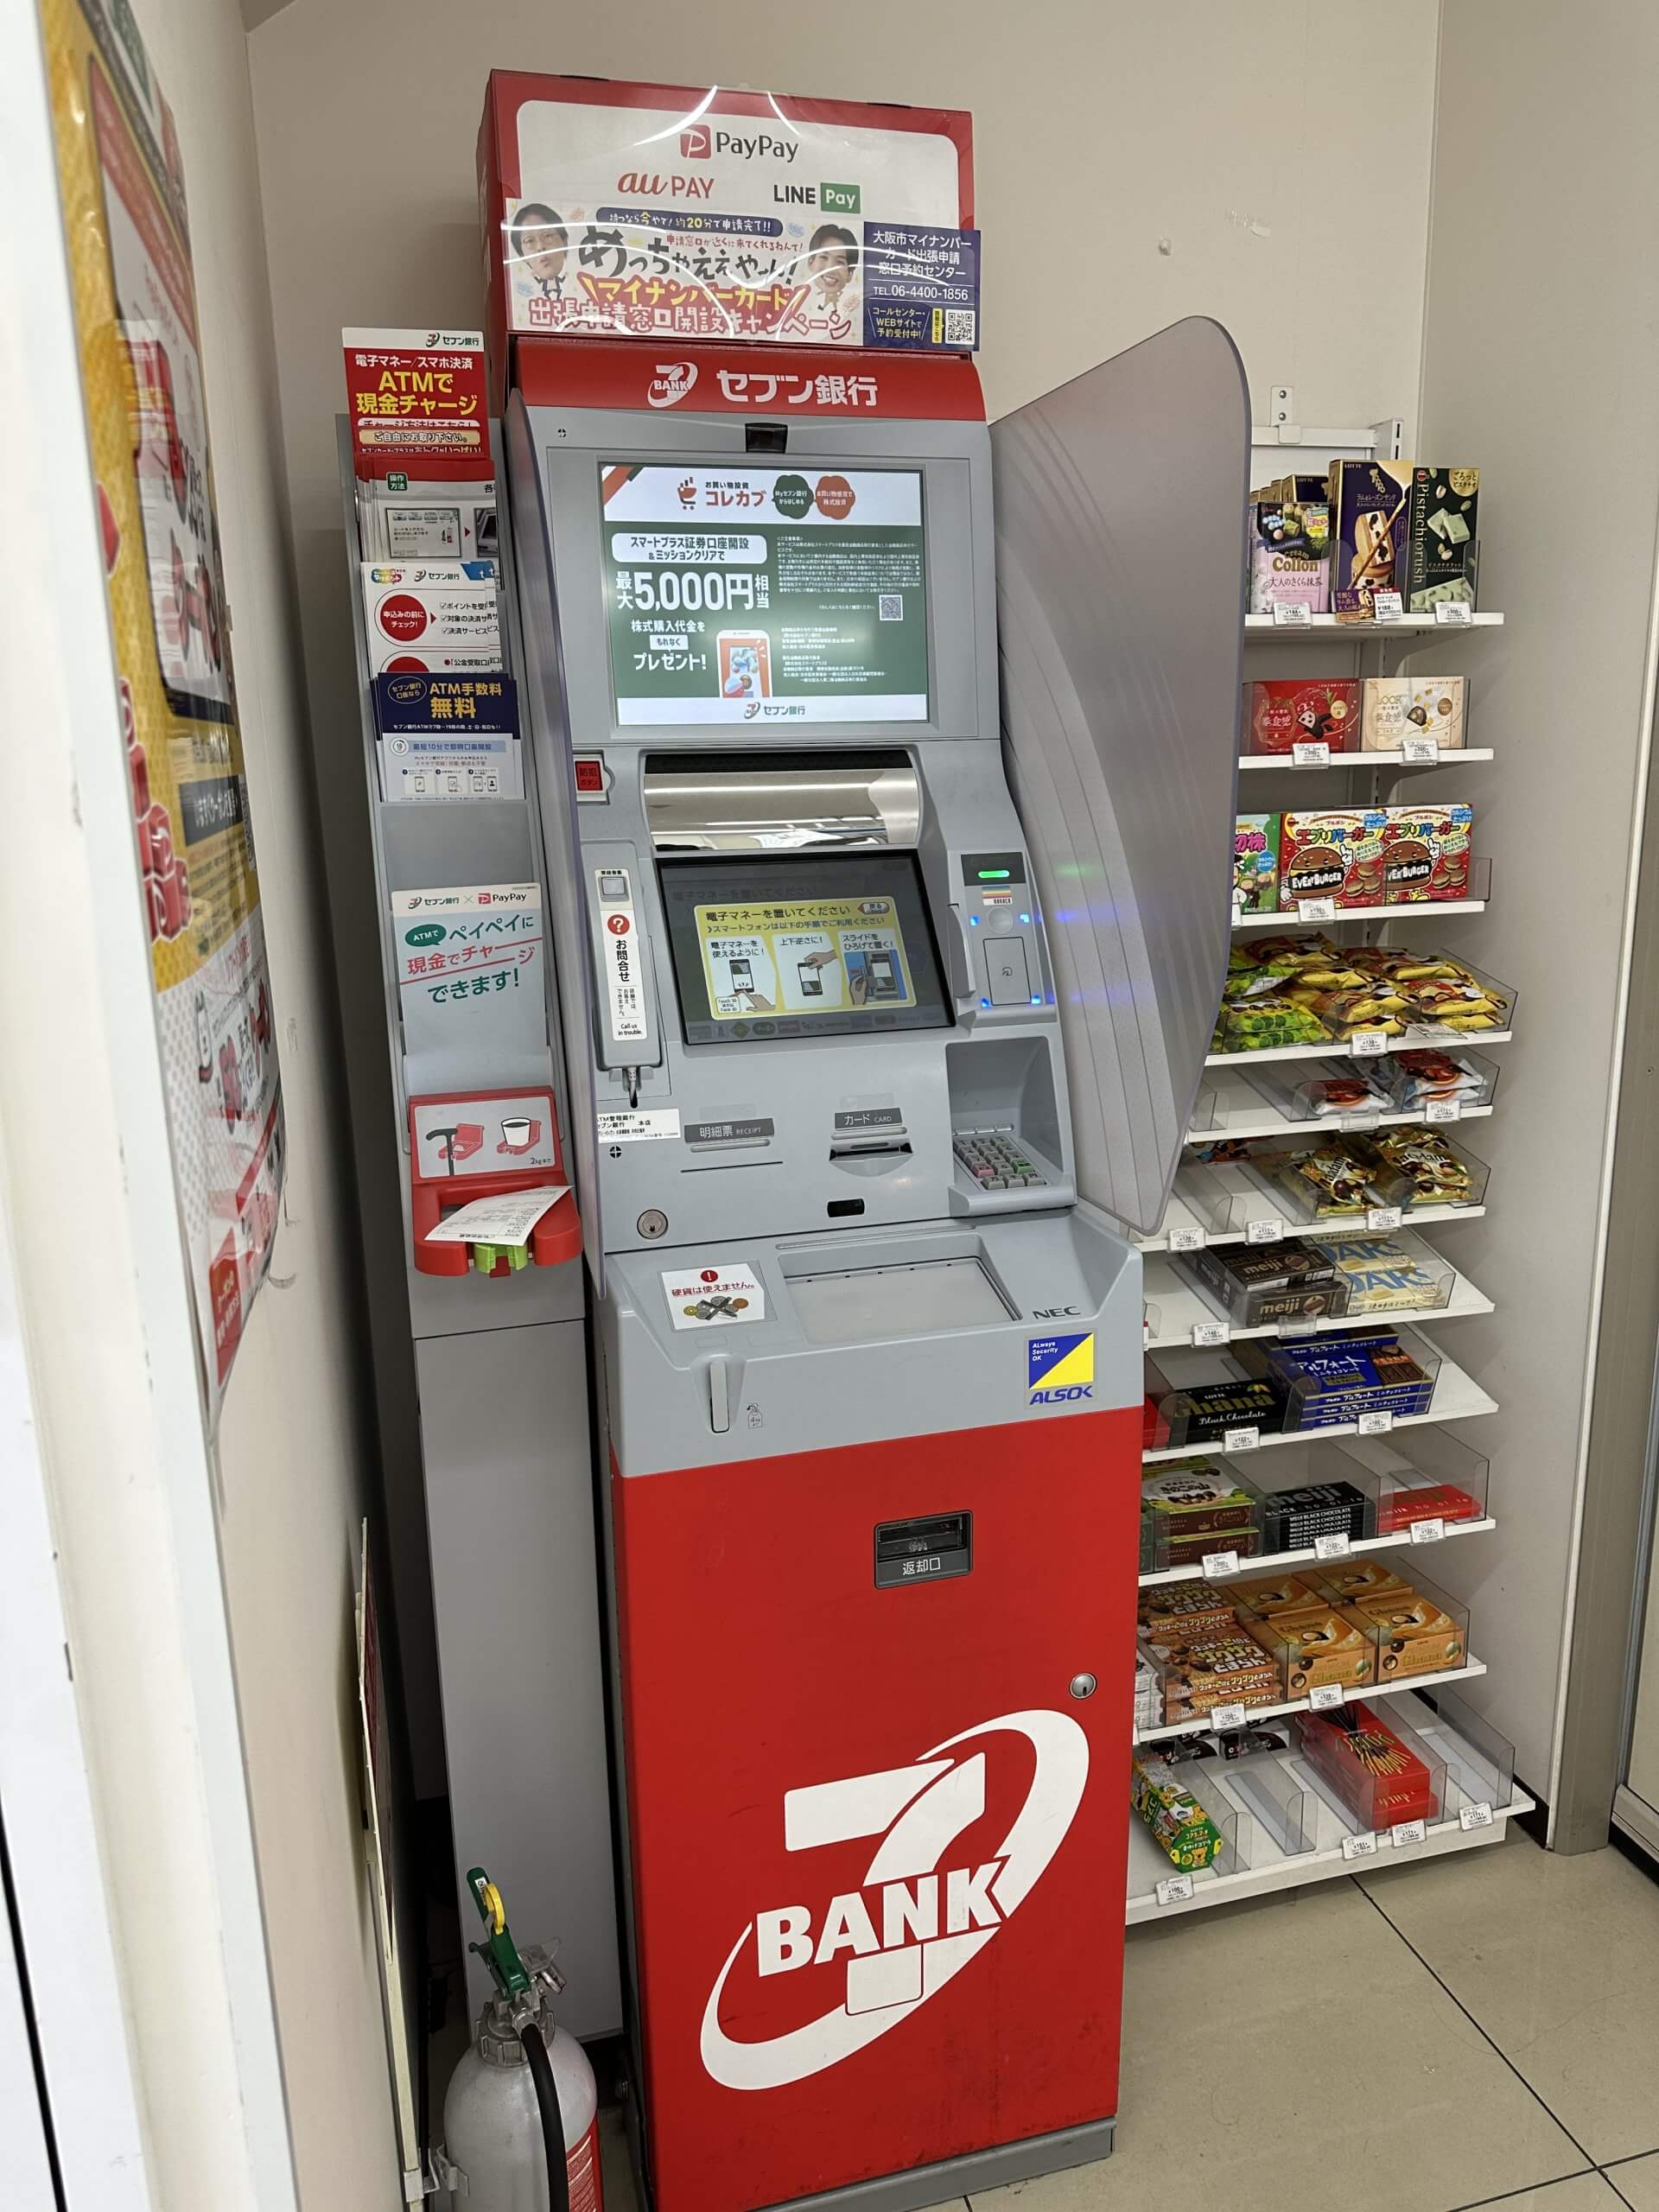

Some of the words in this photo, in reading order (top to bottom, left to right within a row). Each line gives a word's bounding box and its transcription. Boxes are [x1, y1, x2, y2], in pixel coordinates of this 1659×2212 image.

[716, 130, 798, 162] PayPay
[618, 172, 669, 196] au
[671, 176, 715, 199] PAY
[774, 185, 816, 205] LINE
[825, 189, 856, 208] Pay
[873, 231, 971, 249] 大阪市マイナンバー
[886, 247, 960, 264] カド出張申請
[442, 335, 480, 346] セブン銀行
[378, 371, 454, 393] ATMで
[654, 379, 690, 391] BANK
[716, 370, 878, 406] セブン銀行
[356, 393, 478, 416] 現金チャージ
[706, 490, 767, 507] コレカブ
[631, 537, 749, 550] スマートプラス証券口座開設
[1272, 557, 1319, 572] Collon
[631, 620, 705, 632] 株式購入代金を
[657, 638, 681, 646] もれなく
[633, 652, 706, 671] プレゼント!
[429, 683, 502, 696] ATM手数料
[430, 696, 476, 719] 無料
[764, 705, 805, 715] セブン銀行
[1296, 827, 1375, 845] エブリバーガー
[1386, 821, 1461, 839] エブリバーガー
[1387, 865, 1430, 881] VERYBURGER
[424, 897, 460, 906] セブン銀行
[493, 893, 527, 902] PayPay
[706, 906, 850, 922] 電子マネーを置いてください
[449, 914, 534, 940] ペイペイに
[413, 930, 439, 942] ATMで
[710, 940, 759, 949] 電子マネーを
[843, 933, 878, 942] スライドを
[616, 939, 630, 982] お問合せ
[428, 968, 519, 1003] できます!
[844, 1114, 870, 1125] カード
[874, 1115, 892, 1123] CARD
[699, 1125, 734, 1139] 明細票
[1245, 1256, 1283, 1274] meiji
[1033, 1306, 1082, 1319] NEC
[1260, 1298, 1300, 1315] meiji
[1029, 1385, 1093, 1405] ALSOK
[1268, 1485, 1342, 1508] meiji
[902, 1557, 941, 1575] 返却口
[1198, 1645, 1265, 1663] ザクザク
[756, 1860, 1002, 1977] BANK
